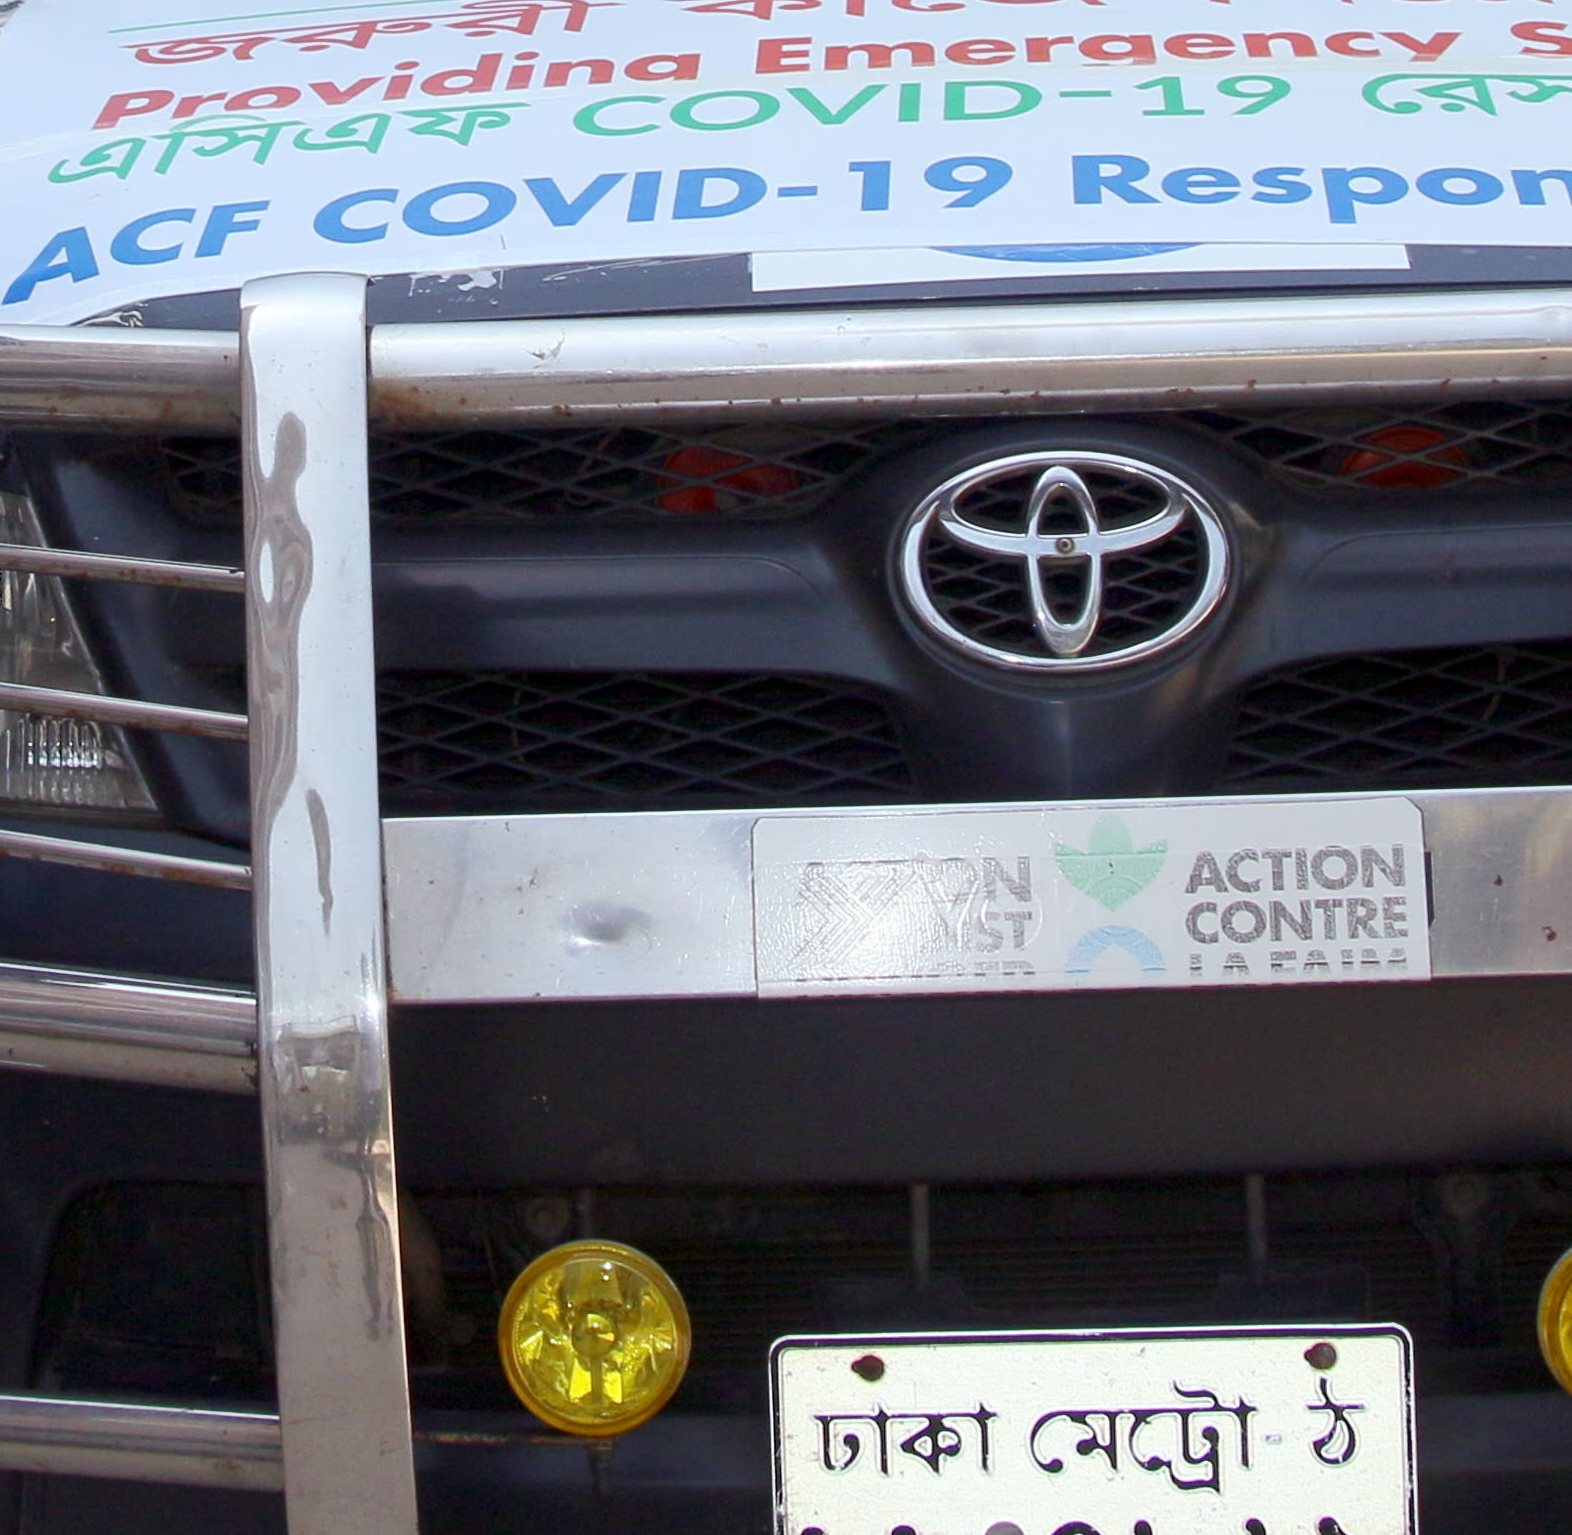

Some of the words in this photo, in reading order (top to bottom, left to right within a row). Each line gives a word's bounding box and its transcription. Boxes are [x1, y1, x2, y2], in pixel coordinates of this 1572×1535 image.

[48, 101, 527, 186] এসিএফ
[572, 75, 1293, 137] COVID-19
[1, 199, 271, 306] ACF
[312, 156, 1014, 245] COVID-19
[1184, 844, 1407, 894] ACTION
[1184, 896, 1409, 945] CONTRE
[814, 1402, 999, 1476] ঢাকা
[1029, 1378, 1258, 1494] মেট্রো
[1306, 1377, 1368, 1466] ঠ
